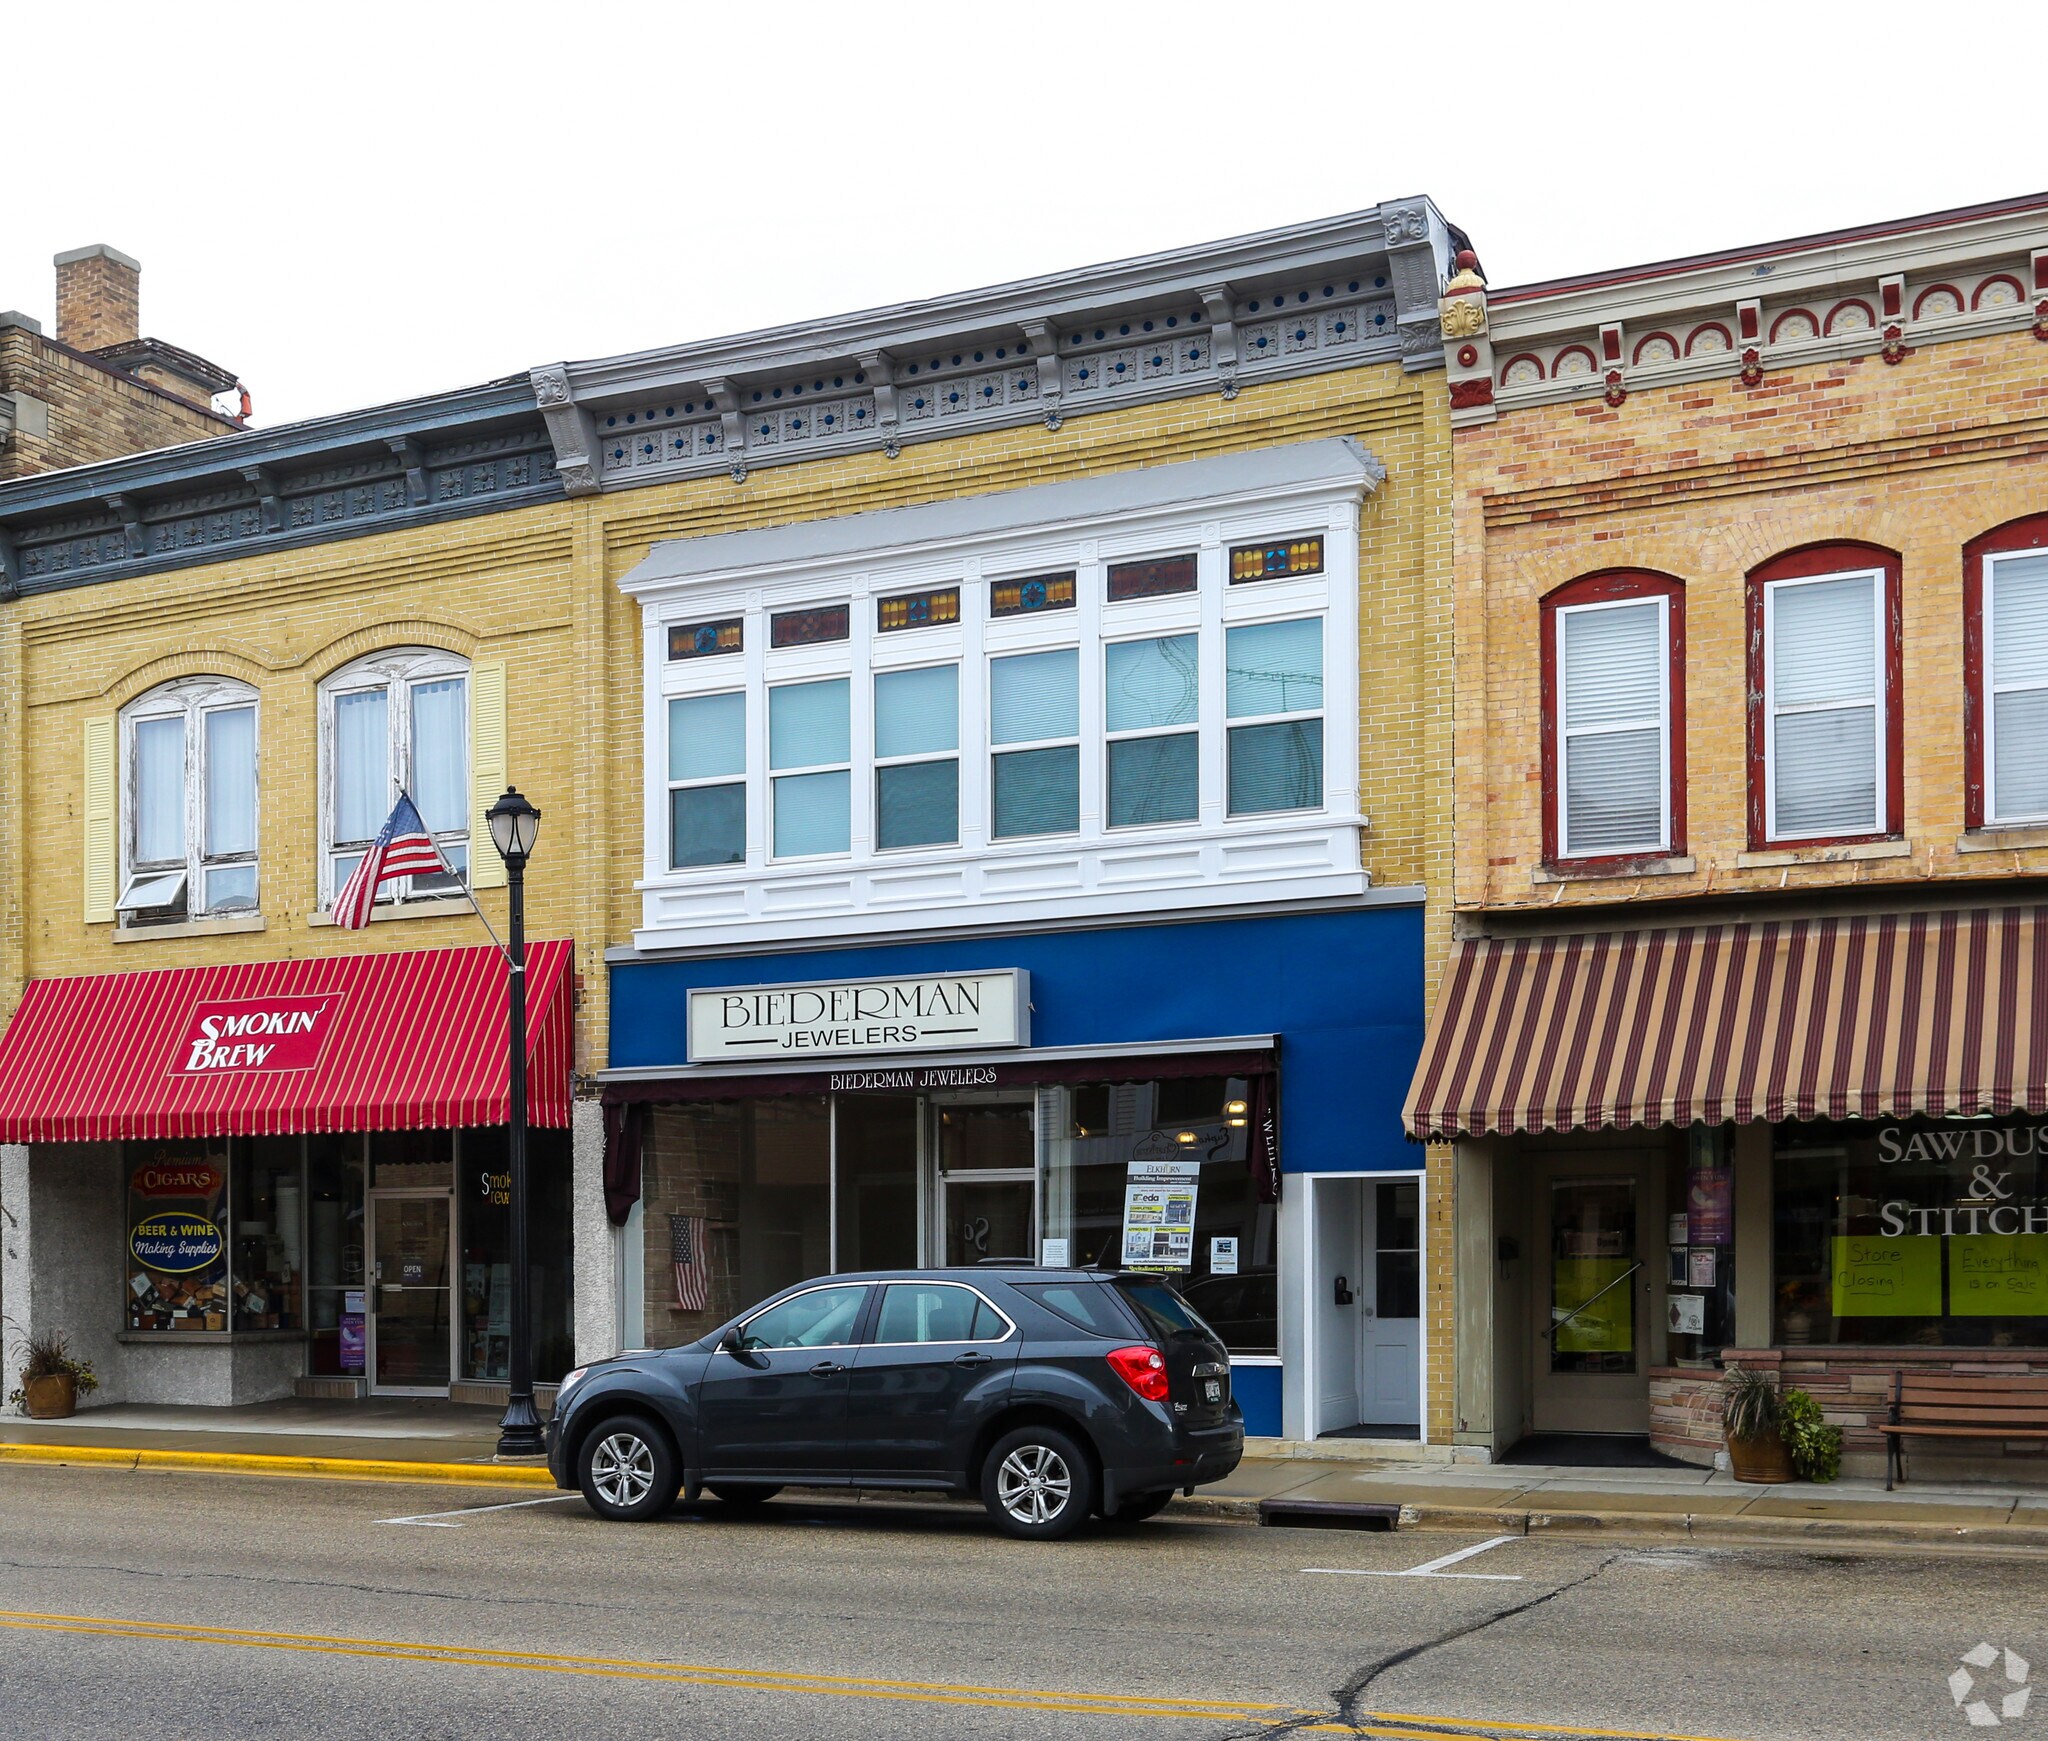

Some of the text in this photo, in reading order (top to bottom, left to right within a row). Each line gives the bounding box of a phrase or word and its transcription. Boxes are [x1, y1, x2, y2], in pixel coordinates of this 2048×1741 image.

[720, 980, 983, 1029] BIEDERMAN
[781, 1025, 917, 1049] JEWELERS
[184, 1039, 275, 1071] BREW
[830, 1067, 997, 1091] BIEDERMAN JEWELERS
[152, 1149, 203, 1168] Premium
[143, 1170, 211, 1189] CIGARS
[1968, 1164, 2014, 1200] &
[138, 1224, 215, 1236] BEER & WINE
[135, 1240, 218, 1259] Making Supplies
[1849, 1243, 1903, 1263] Store
[403, 1265, 422, 1274] OPEN
[1962, 1247, 2041, 1275] Everything
[1986, 1281, 2000, 1289] on
